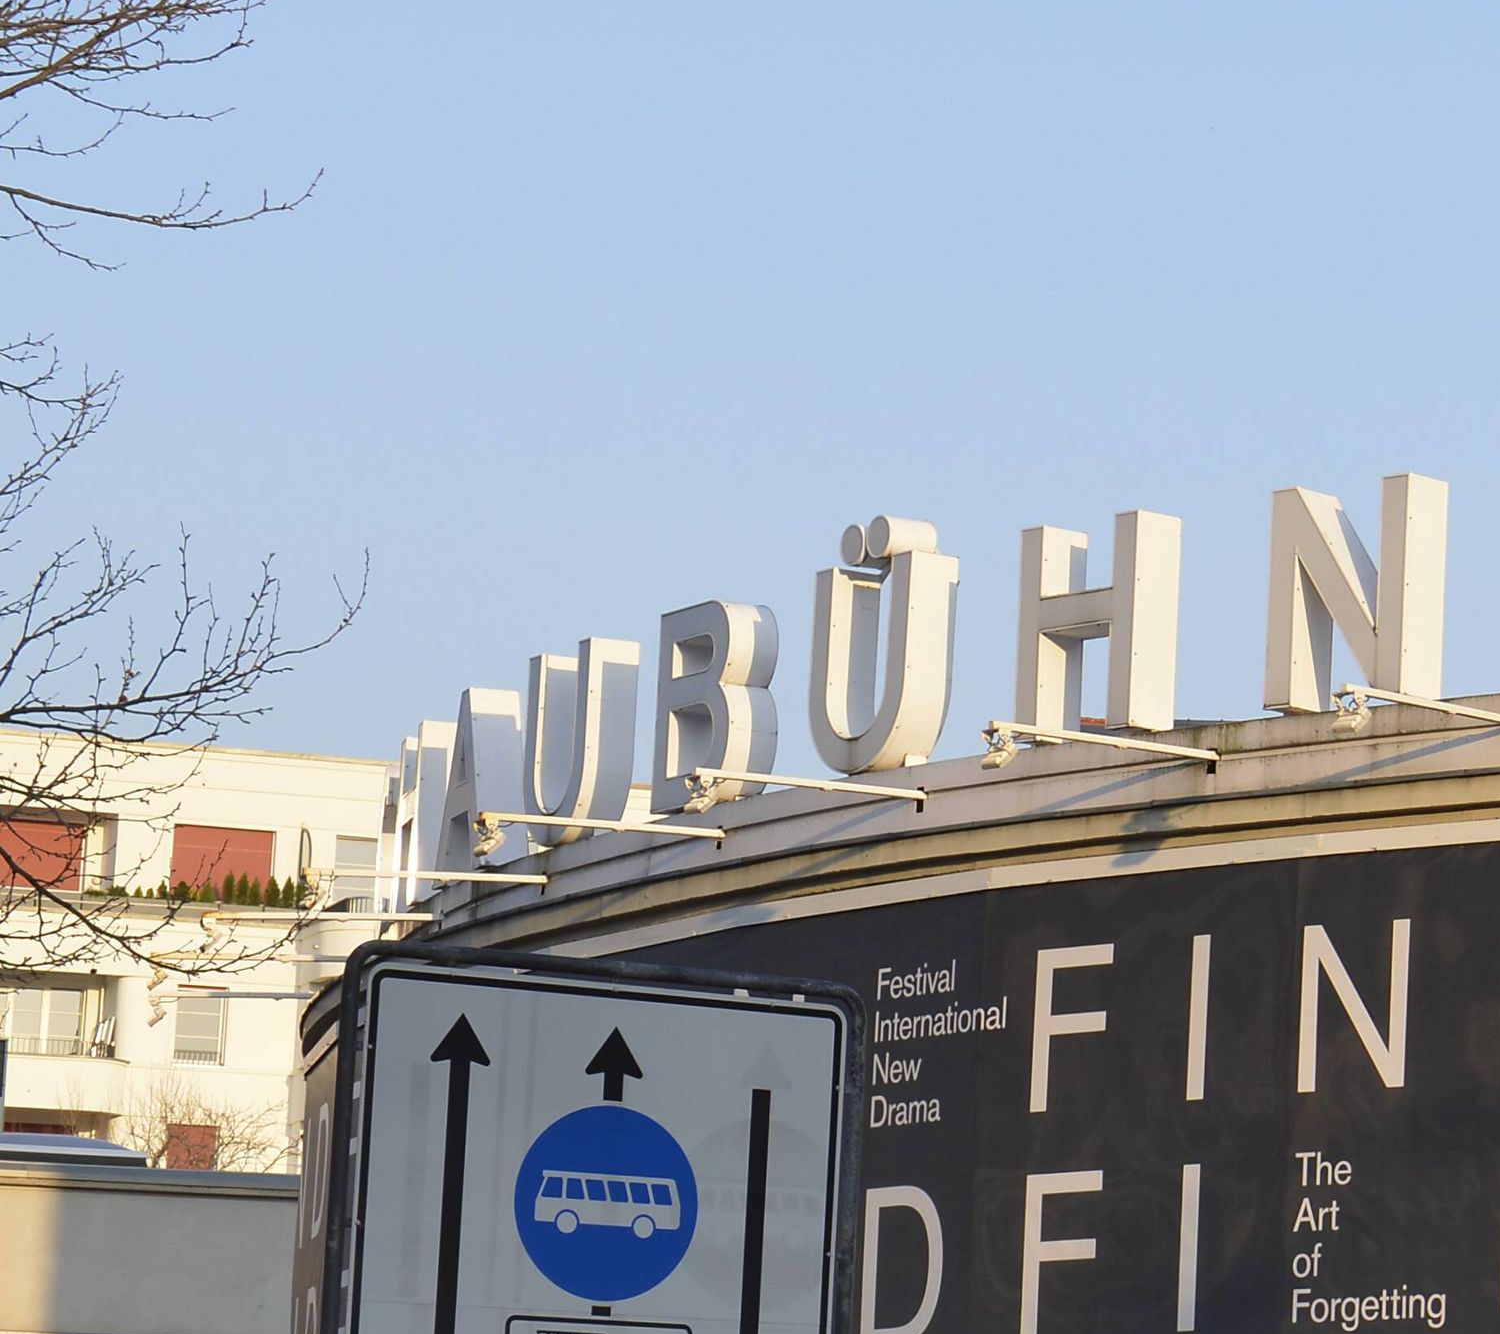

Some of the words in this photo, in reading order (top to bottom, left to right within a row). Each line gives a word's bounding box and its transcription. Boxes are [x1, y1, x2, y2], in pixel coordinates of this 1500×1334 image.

[876, 961, 956, 1001] Festival
[873, 997, 1008, 1043] International
[871, 1052, 921, 1085] New
[869, 1094, 940, 1130] Drama
[1295, 1151, 1352, 1189] The
[1293, 1197, 1340, 1235] Art
[1292, 1243, 1322, 1279] of
[1291, 1286, 1447, 1331] Forgetting
